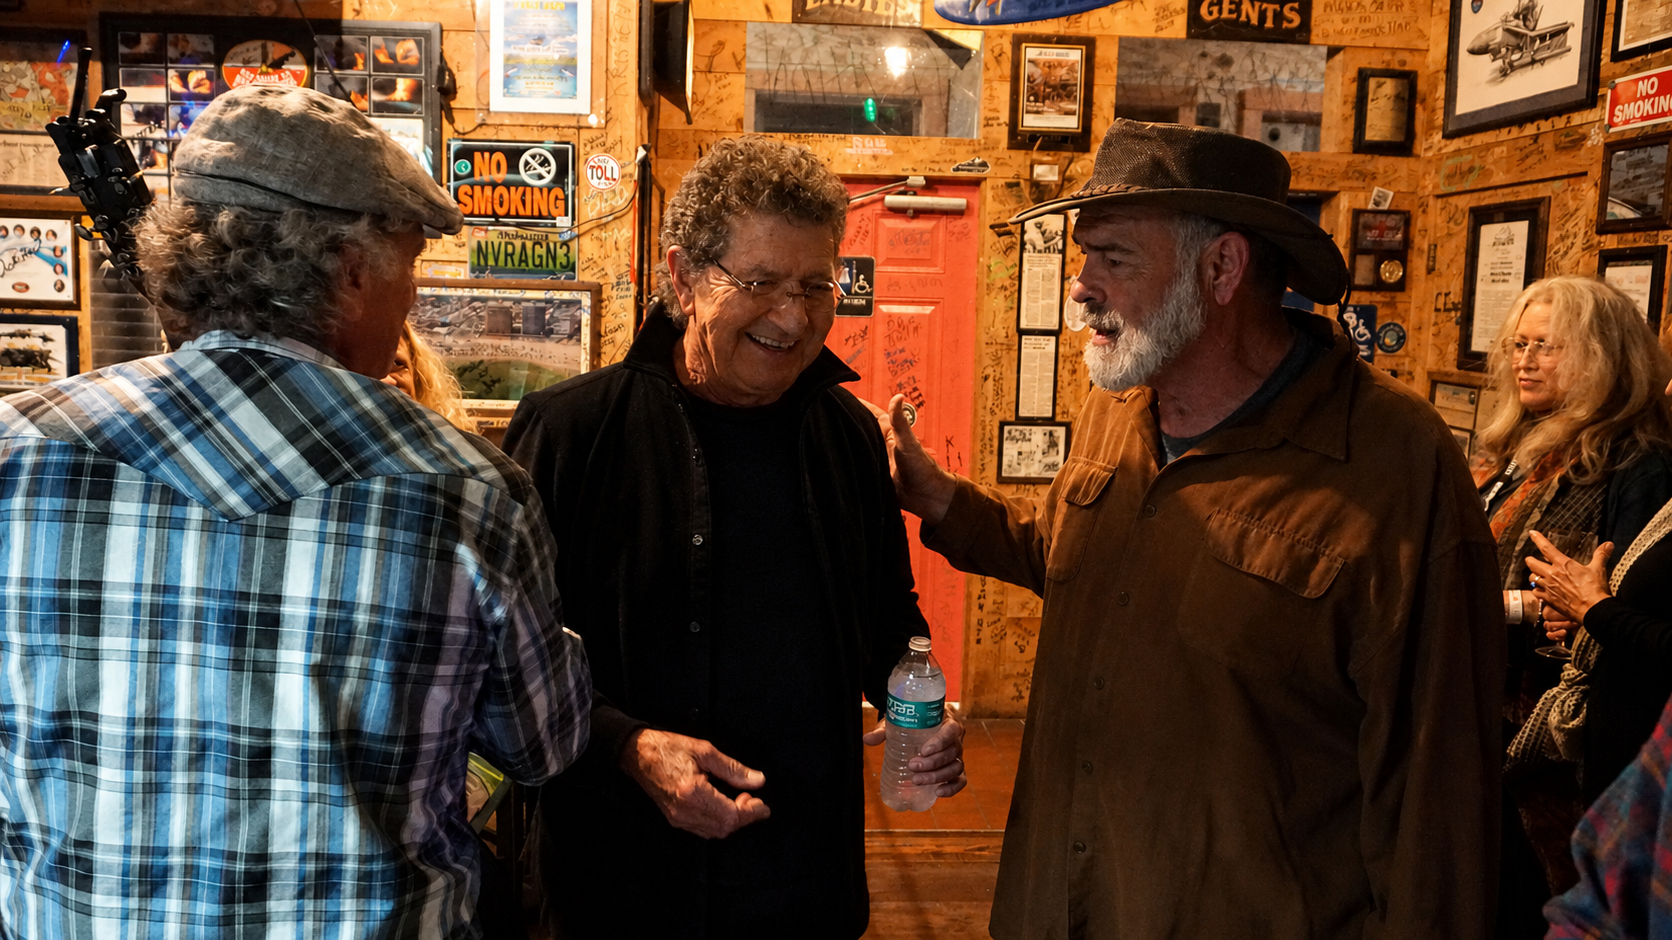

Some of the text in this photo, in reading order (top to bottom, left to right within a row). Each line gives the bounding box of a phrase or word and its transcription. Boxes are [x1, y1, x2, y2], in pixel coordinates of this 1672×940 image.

[1199, 0, 1301, 29] GENTS
[1636, 76, 1659, 98] NO
[1613, 94, 1672, 123] SMOKIN
[473, 151, 508, 183] NO
[588, 164, 617, 182] TOLL
[457, 184, 565, 217] SMOKING
[476, 240, 571, 270] NVRAGN3
